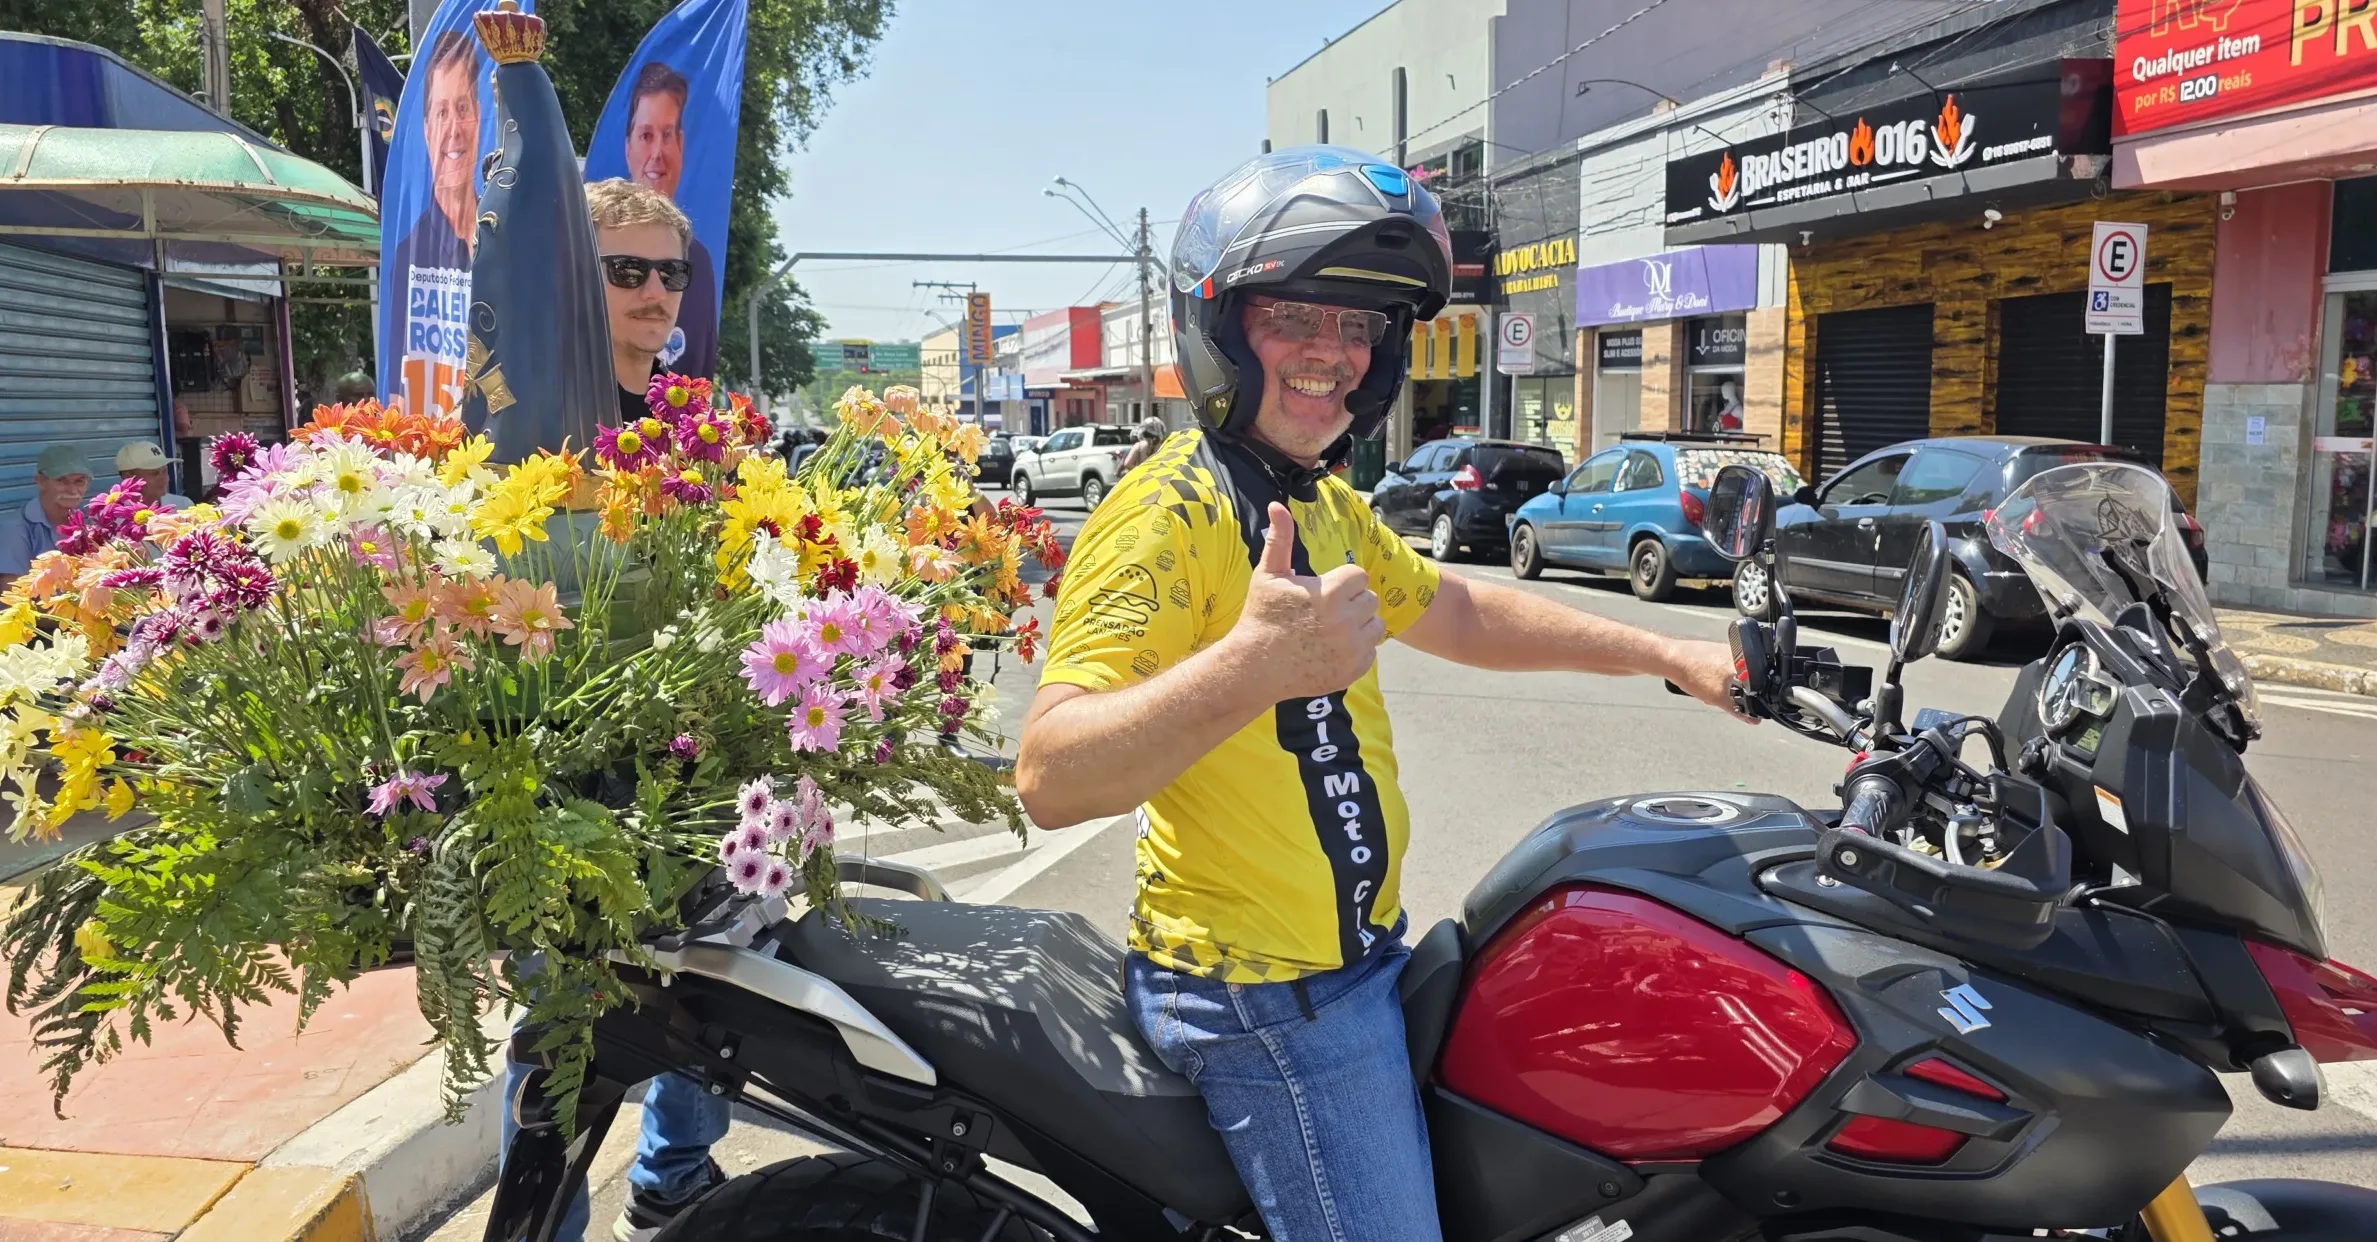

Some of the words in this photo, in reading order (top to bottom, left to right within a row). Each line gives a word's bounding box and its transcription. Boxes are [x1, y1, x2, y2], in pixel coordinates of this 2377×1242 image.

[2132, 44, 2214, 82] Qualquer
[2217, 33, 2261, 61] item
[2135, 93, 2158, 113] por
[2159, 85, 2176, 104] R$
[2218, 69, 2252, 93] reais
[1741, 131, 1849, 197] BRASEIRO
[1875, 120, 1927, 166] 016
[1777, 180, 1832, 202] ESPETARIA
[1834, 178, 1843, 190] &
[1846, 172, 1870, 188] BAR
[1491, 237, 1576, 276] ADVOCACIA
[2110, 240, 2127, 272] E
[411, 272, 448, 286] Deputado
[1227, 263, 1264, 283] GECKO
[1501, 274, 1558, 295] TRABALHISTA
[1675, 294, 1683, 310] &
[410, 321, 465, 359] ROSS
[971, 294, 990, 361] MINGO
[1512, 323, 1524, 340] E
[1712, 328, 1746, 343] OFICIN
[1621, 337, 1635, 346] PLUS
[1712, 345, 1720, 353] DA
[1083, 618, 1145, 637] PRENSADÃO
[1324, 771, 1372, 865] Moto
[1353, 880, 1376, 957] Clu
